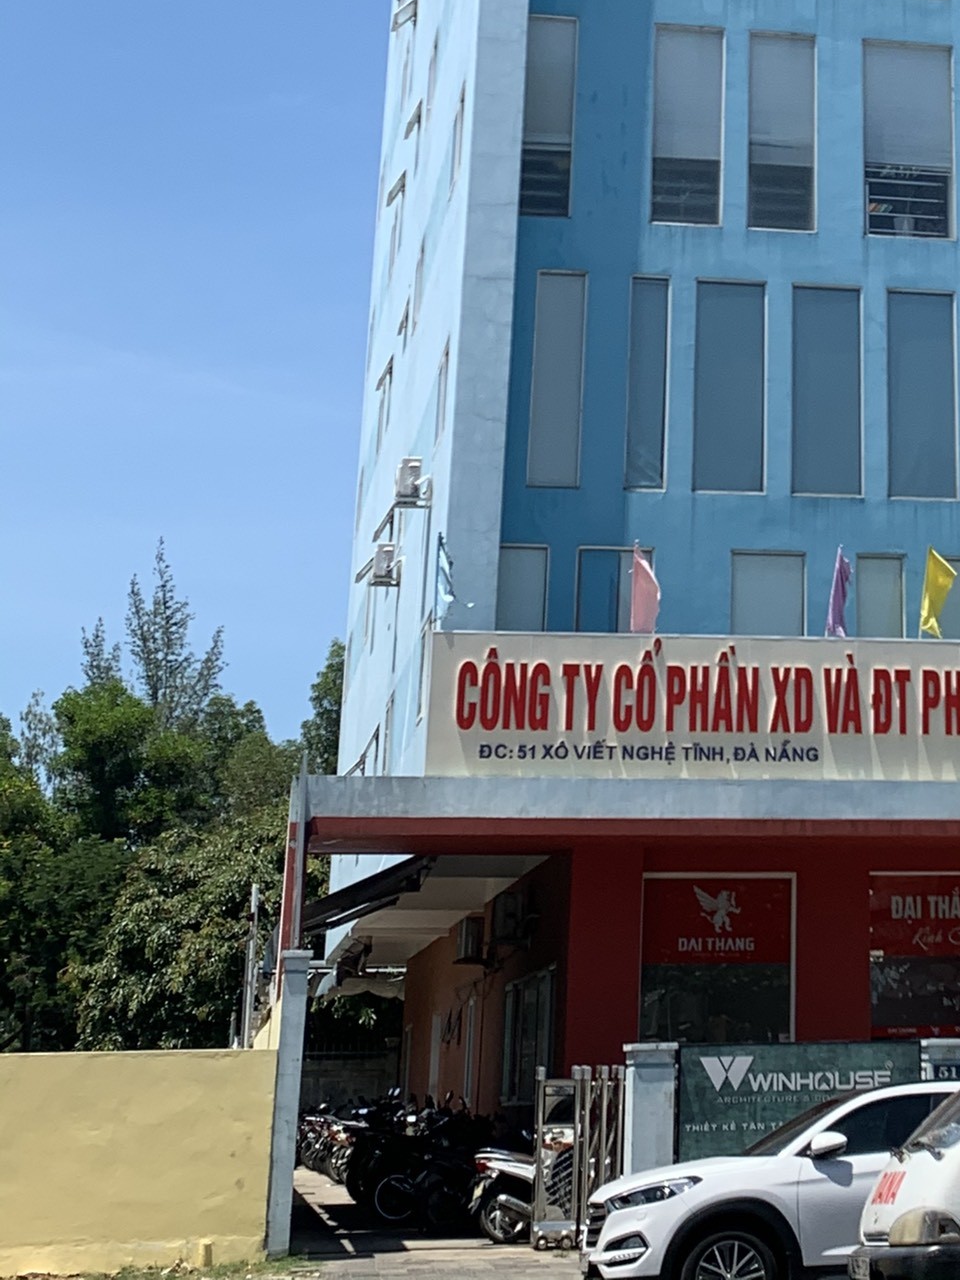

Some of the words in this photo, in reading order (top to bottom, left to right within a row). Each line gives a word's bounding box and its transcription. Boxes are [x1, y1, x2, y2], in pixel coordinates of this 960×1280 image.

[456, 647, 550, 731] CÔNG
[562, 662, 604, 732] TY
[613, 637, 662, 733] CỔ
[665, 645, 760, 733] PHẦN
[770, 666, 814, 733] XD
[824, 653, 862, 735] VÀ
[872, 668, 911, 735] ĐT
[479, 744, 513, 760] ĐC:
[517, 744, 536, 759] 51
[541, 740, 569, 760] XÔ
[573, 739, 617, 760] VIẾT
[622, 741, 676, 765] NGHỆ
[733, 742, 759, 762] ĐÀ
[891, 895, 921, 924] ĐẠI
[678, 937, 702, 952] DAI
[705, 937, 755, 951] THANG
[748, 1070, 891, 1092] WINHOUSE
[938, 1066, 957, 1079] 51
